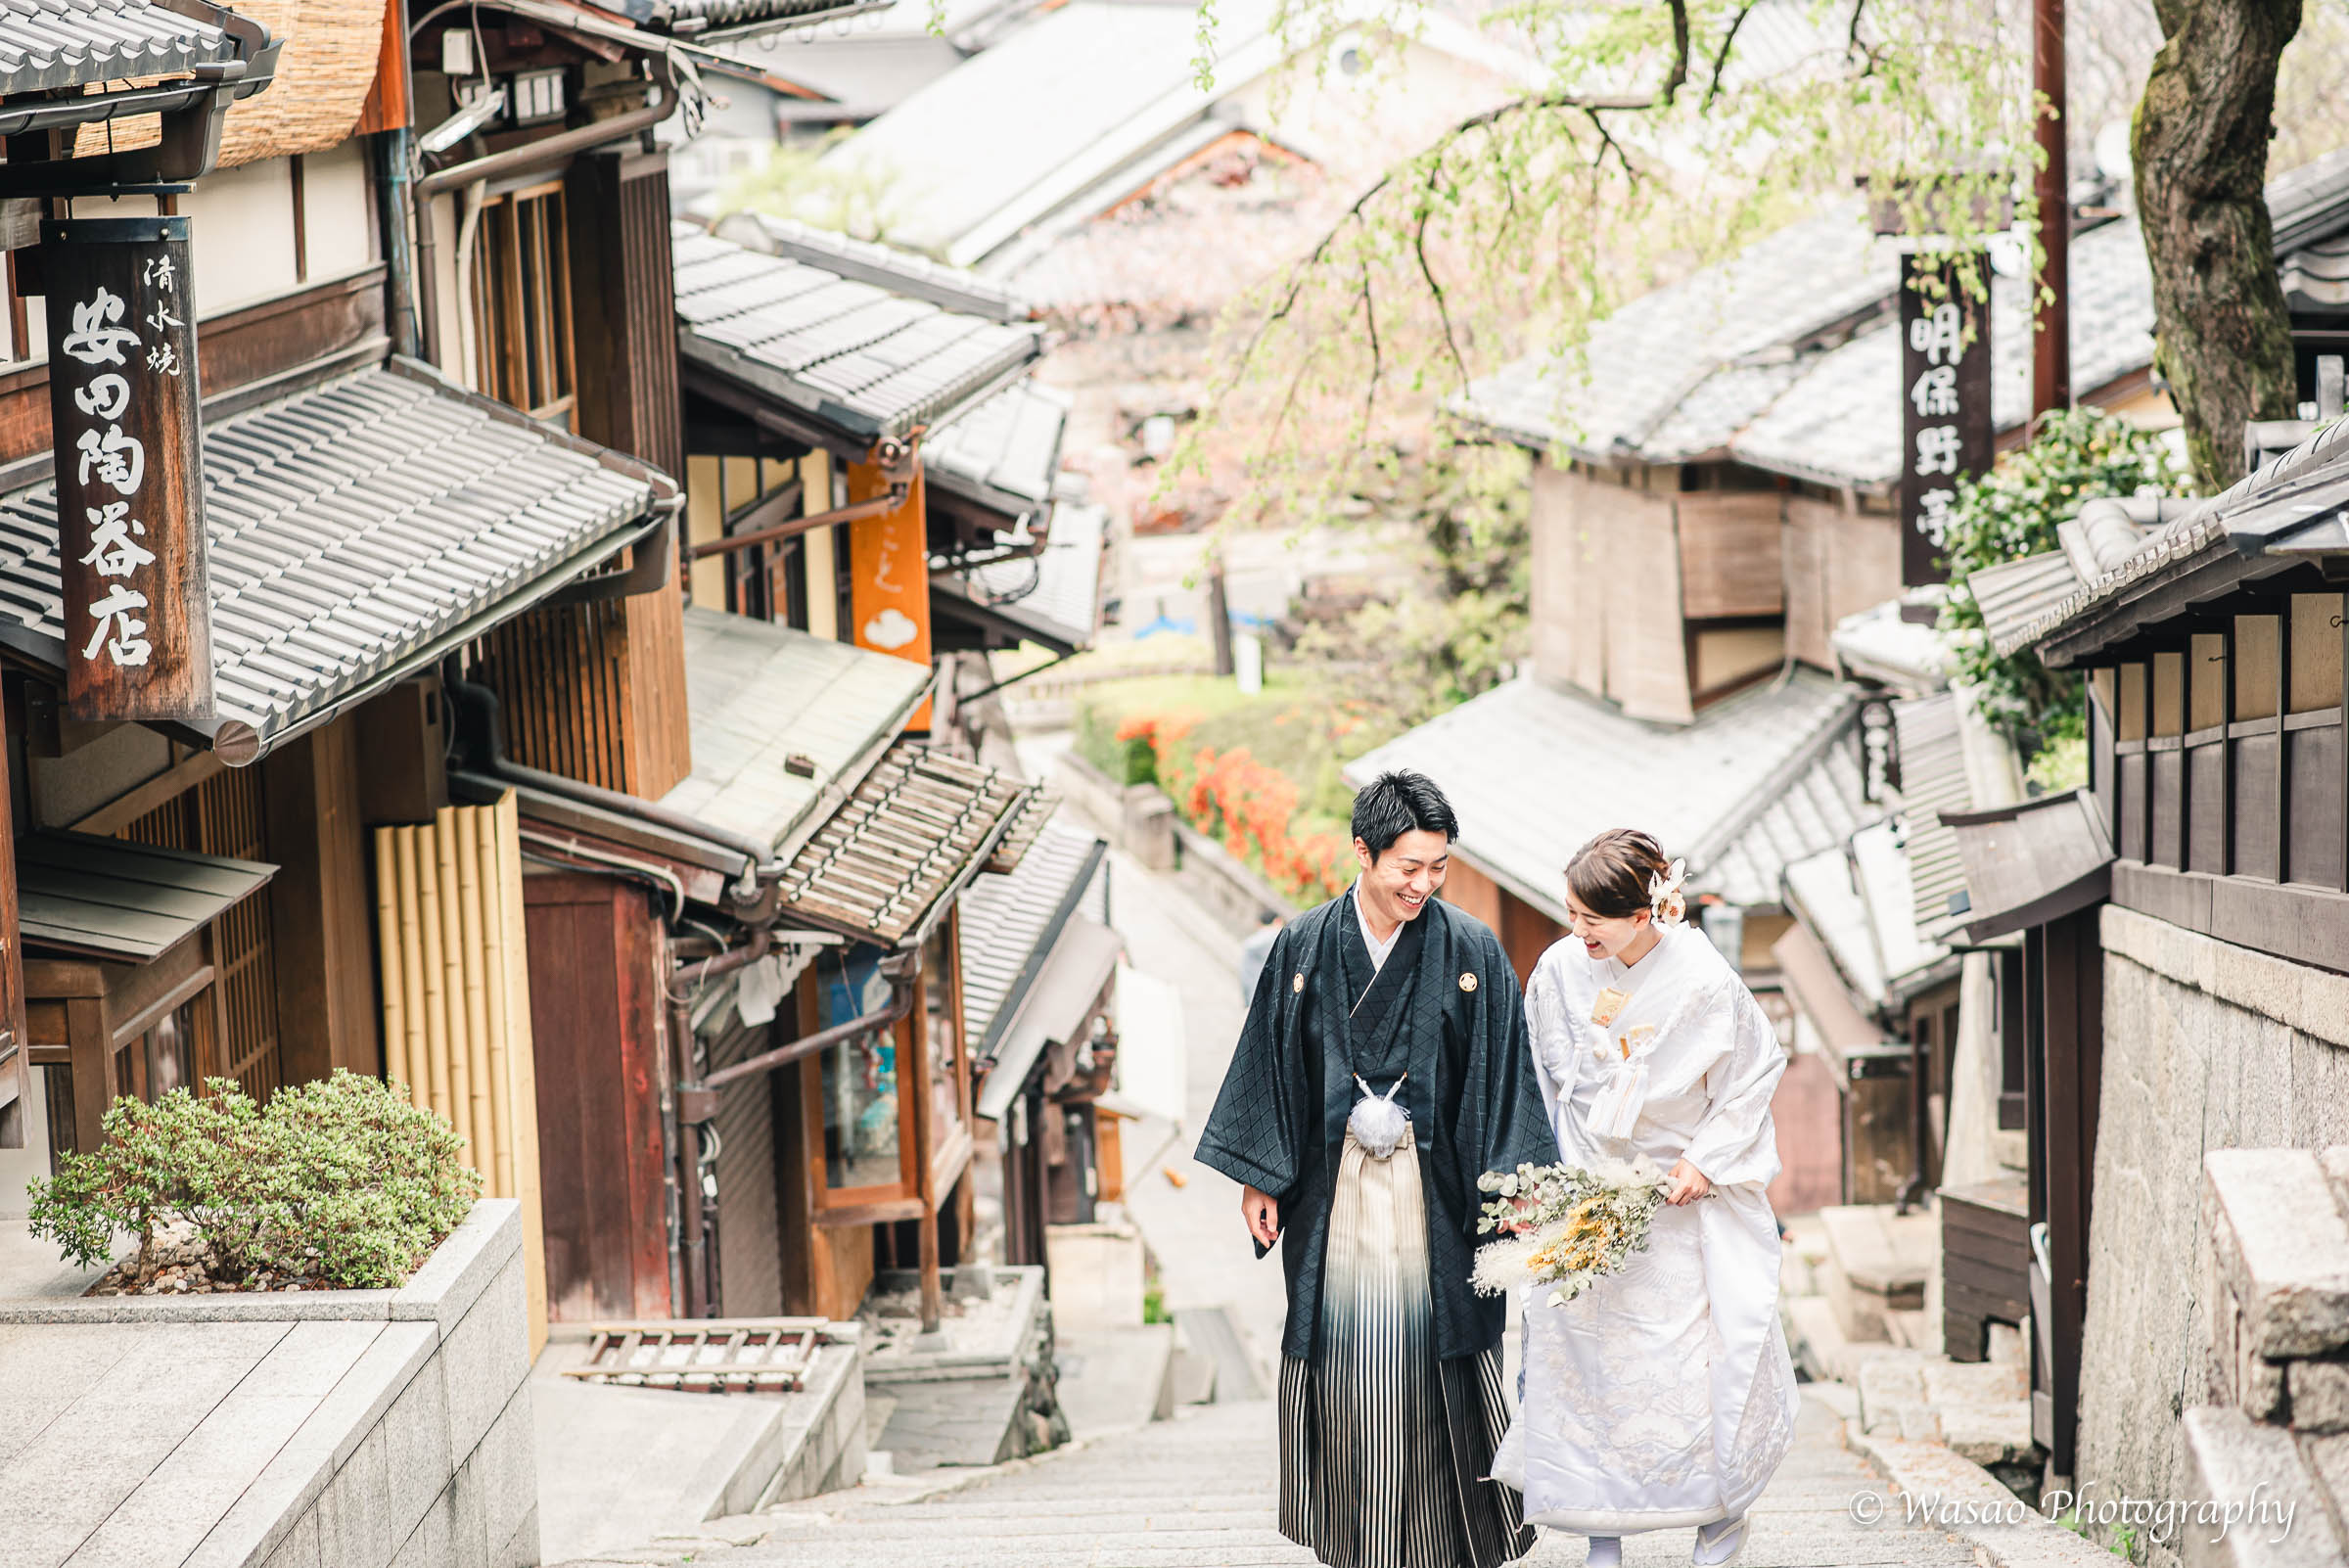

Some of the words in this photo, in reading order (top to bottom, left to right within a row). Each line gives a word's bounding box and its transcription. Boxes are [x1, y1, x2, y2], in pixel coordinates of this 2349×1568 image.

[144, 254, 186, 376] 清水焼
[1911, 302, 1963, 548] 明保野亭
[63, 286, 157, 668] 安田陶器店
